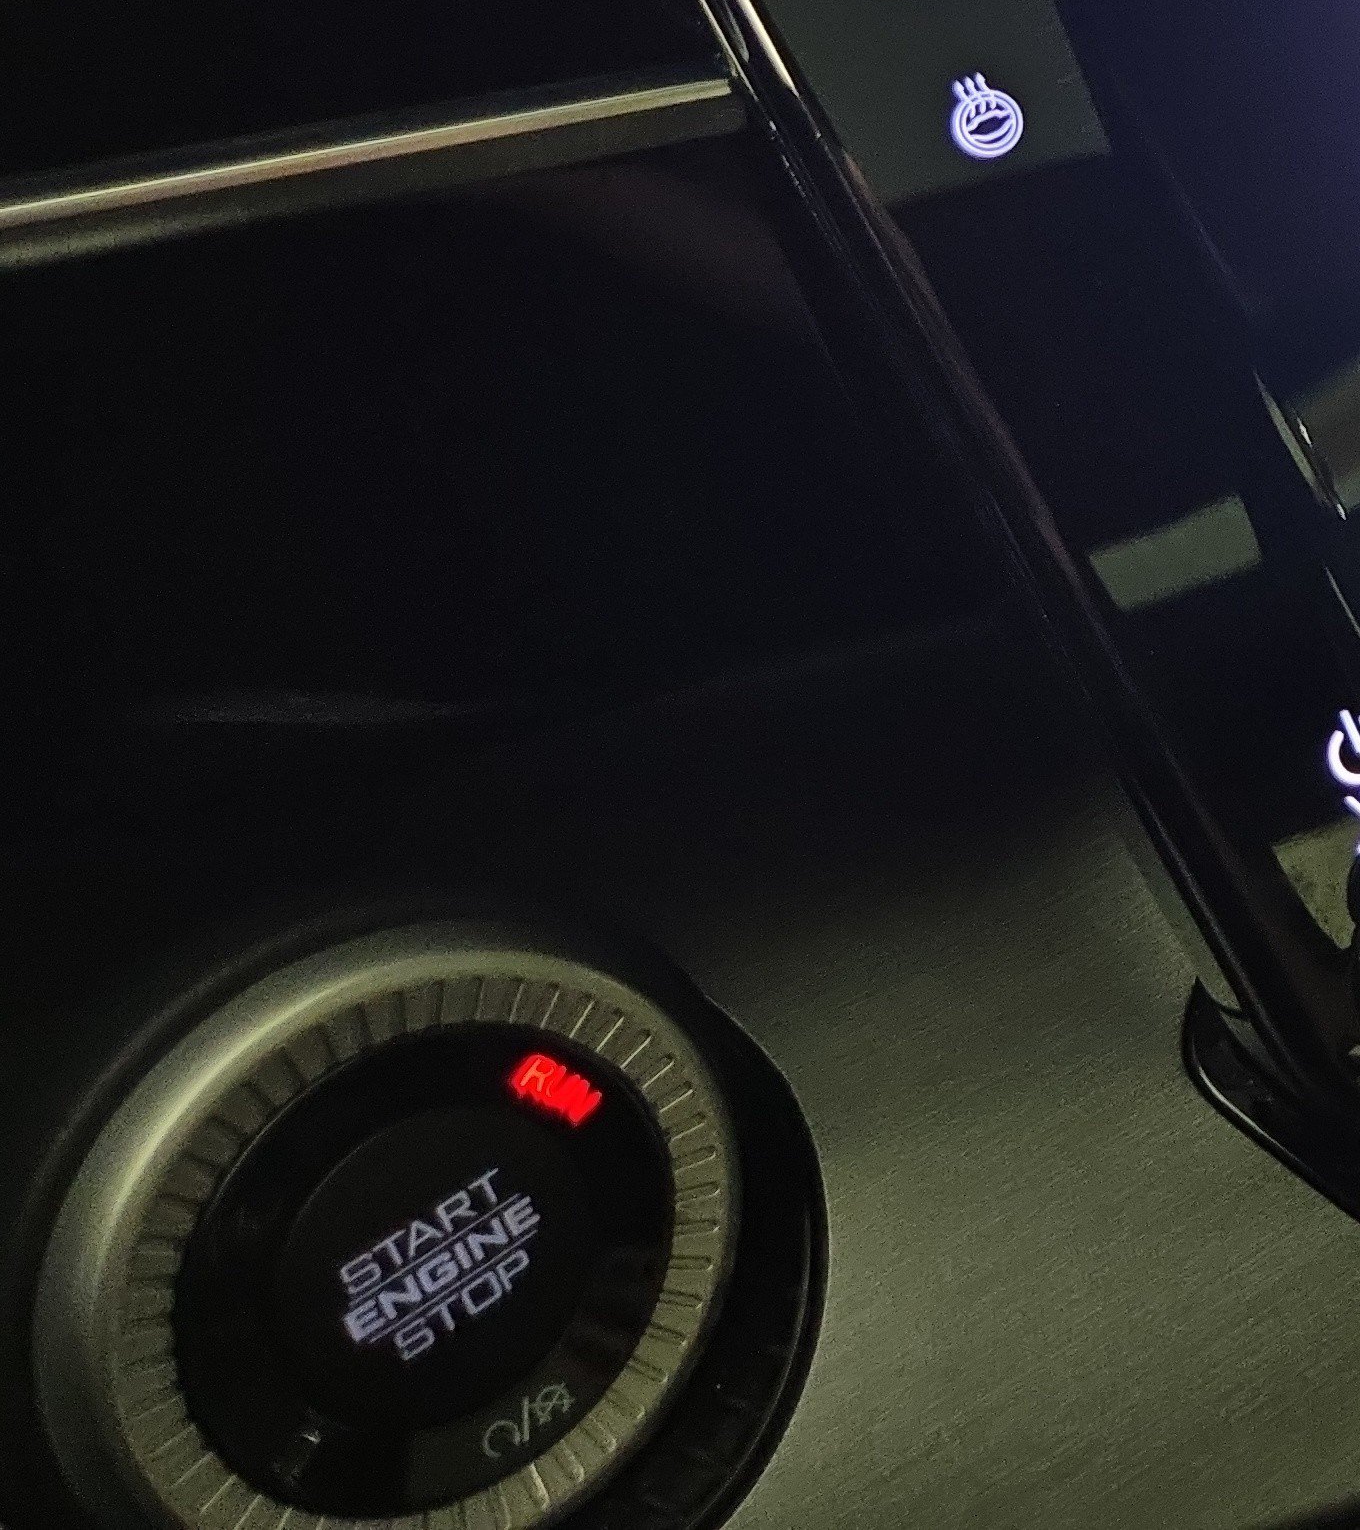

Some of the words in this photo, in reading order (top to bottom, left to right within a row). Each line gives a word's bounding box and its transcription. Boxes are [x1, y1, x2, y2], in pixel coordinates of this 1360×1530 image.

[340, 1167, 499, 1296] START
[343, 1195, 541, 1344] ENGINE
[394, 1248, 530, 1361] STOP
